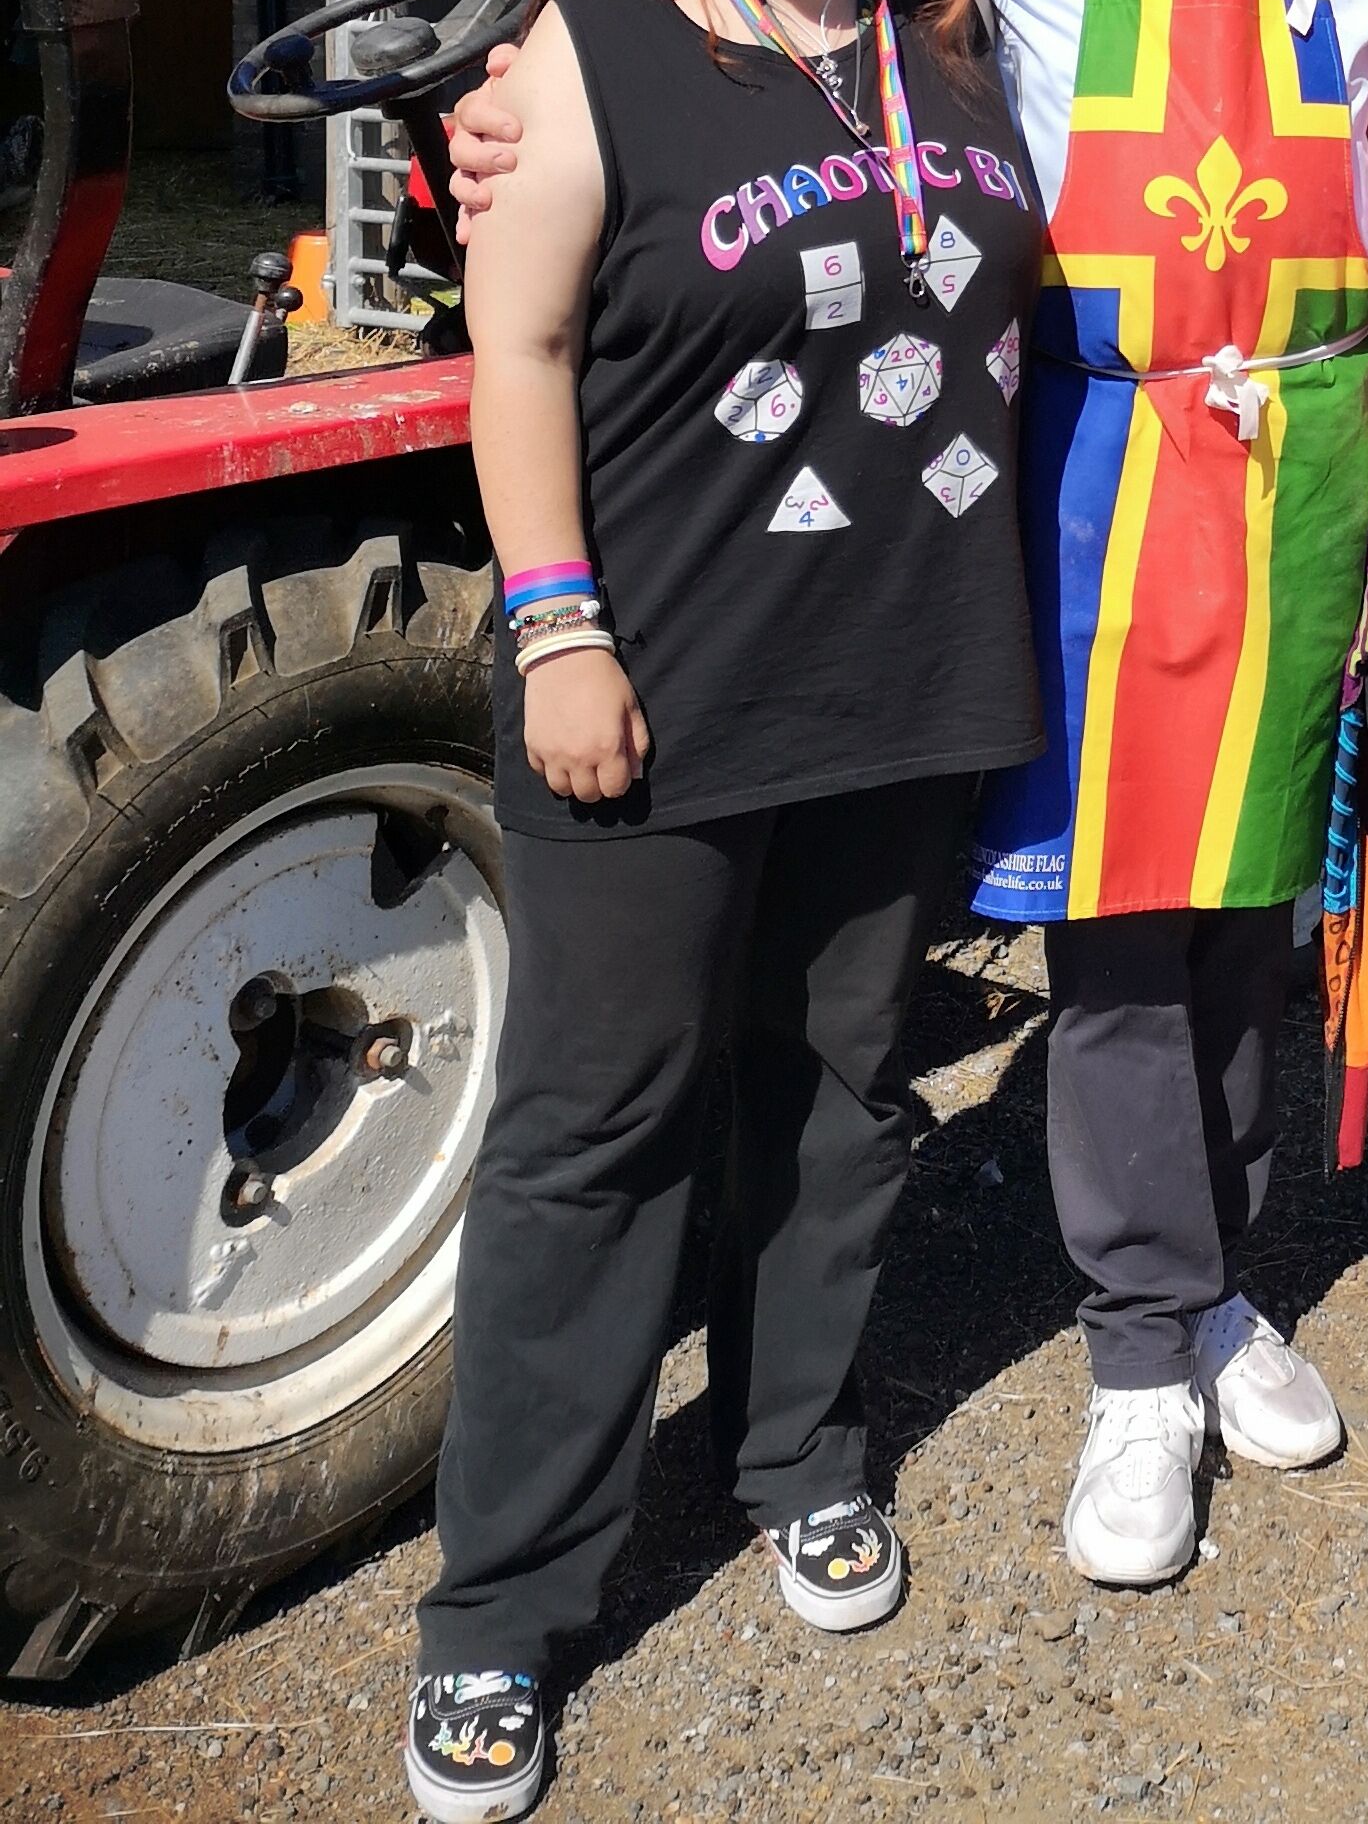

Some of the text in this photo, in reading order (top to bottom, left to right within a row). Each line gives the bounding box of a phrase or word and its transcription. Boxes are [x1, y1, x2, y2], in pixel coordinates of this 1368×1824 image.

[701, 141, 1029, 271] CHAOTC BI
[940, 231, 956, 249] 8
[824, 255, 843, 276] 6
[827, 301, 844, 320] 2
[891, 348, 915, 363] 20
[727, 405, 743, 423] 2
[799, 511, 815, 527] 4
[1036, 854, 1066, 873] FLAG
